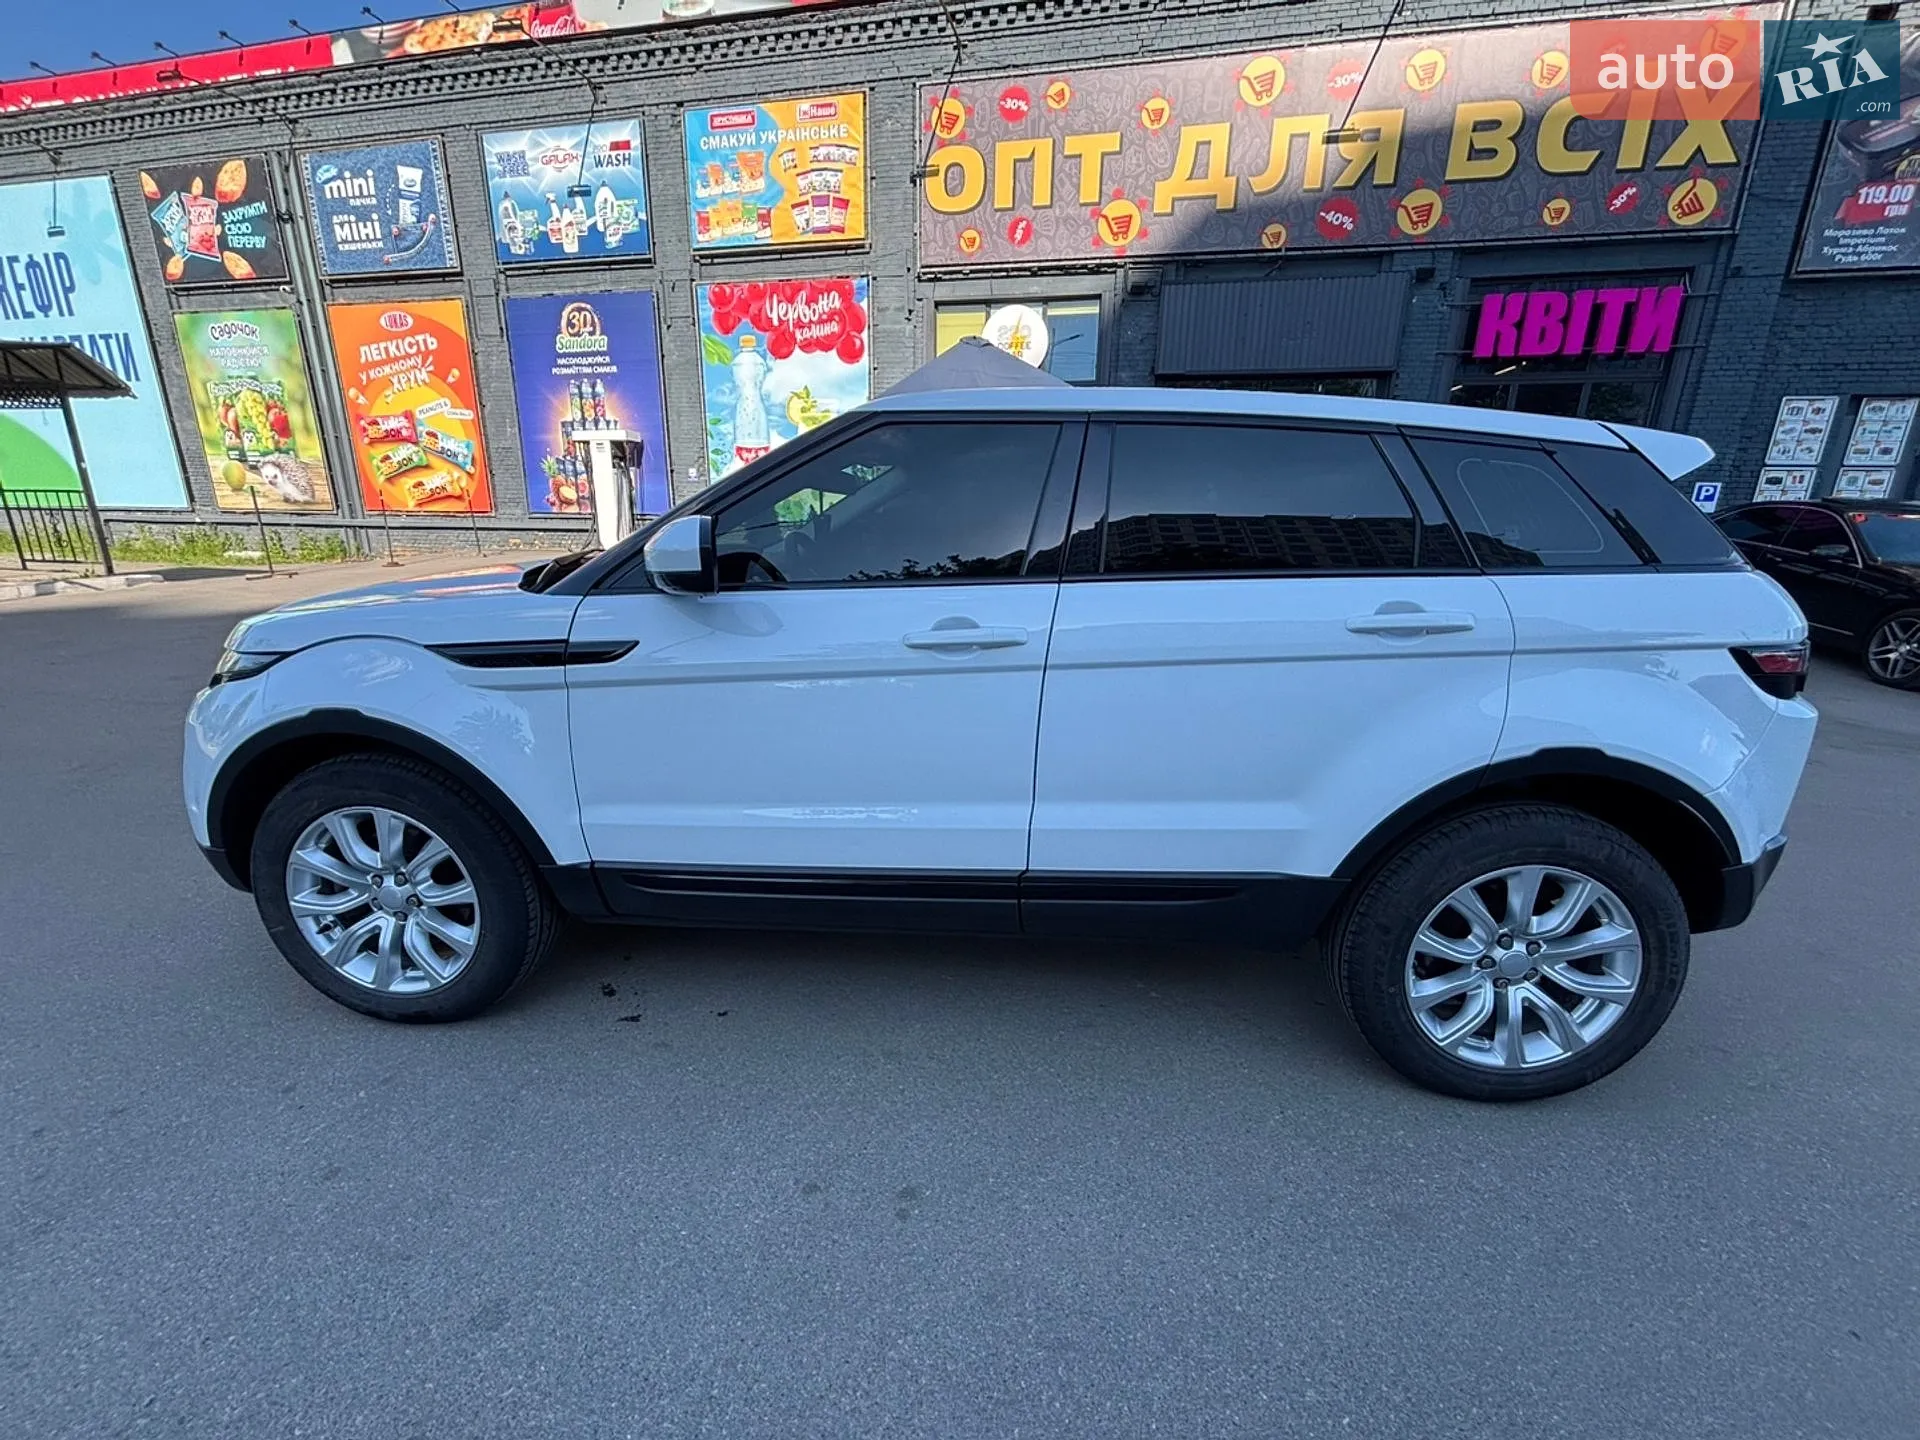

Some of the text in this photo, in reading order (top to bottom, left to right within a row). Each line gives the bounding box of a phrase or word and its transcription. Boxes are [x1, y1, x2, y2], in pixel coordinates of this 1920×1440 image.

[1000, 97, 1029, 111] -30%
[700, 123, 849, 150] СМАКУЙ УКРАЇНСЬКЕ
[924, 80, 1740, 216] ОПТ ДЛЯ ВСІХ
[593, 152, 632, 168] WASH
[324, 169, 376, 199] mini
[1858, 184, 1915, 204] 119.00
[1610, 187, 1637, 210] -30%
[222, 201, 268, 223] ЗАХРУМТИ
[1320, 210, 1354, 230] -40%
[225, 222, 252, 235] СВОЮ
[228, 235, 267, 248] ПЕРЕРВУ
[766, 290, 843, 331] Червона
[384, 313, 409, 329] LUKAS
[795, 320, 840, 341] калина
[1472, 285, 1685, 358] КВІТИ
[360, 332, 438, 364] ЛЕГКІСТЬ
[557, 334, 606, 351] Sandora
[556, 355, 611, 365] НАСОЛОДЖУЙСЯ
[390, 367, 430, 392] ХРУМ
[1700, 486, 1715, 500] P
